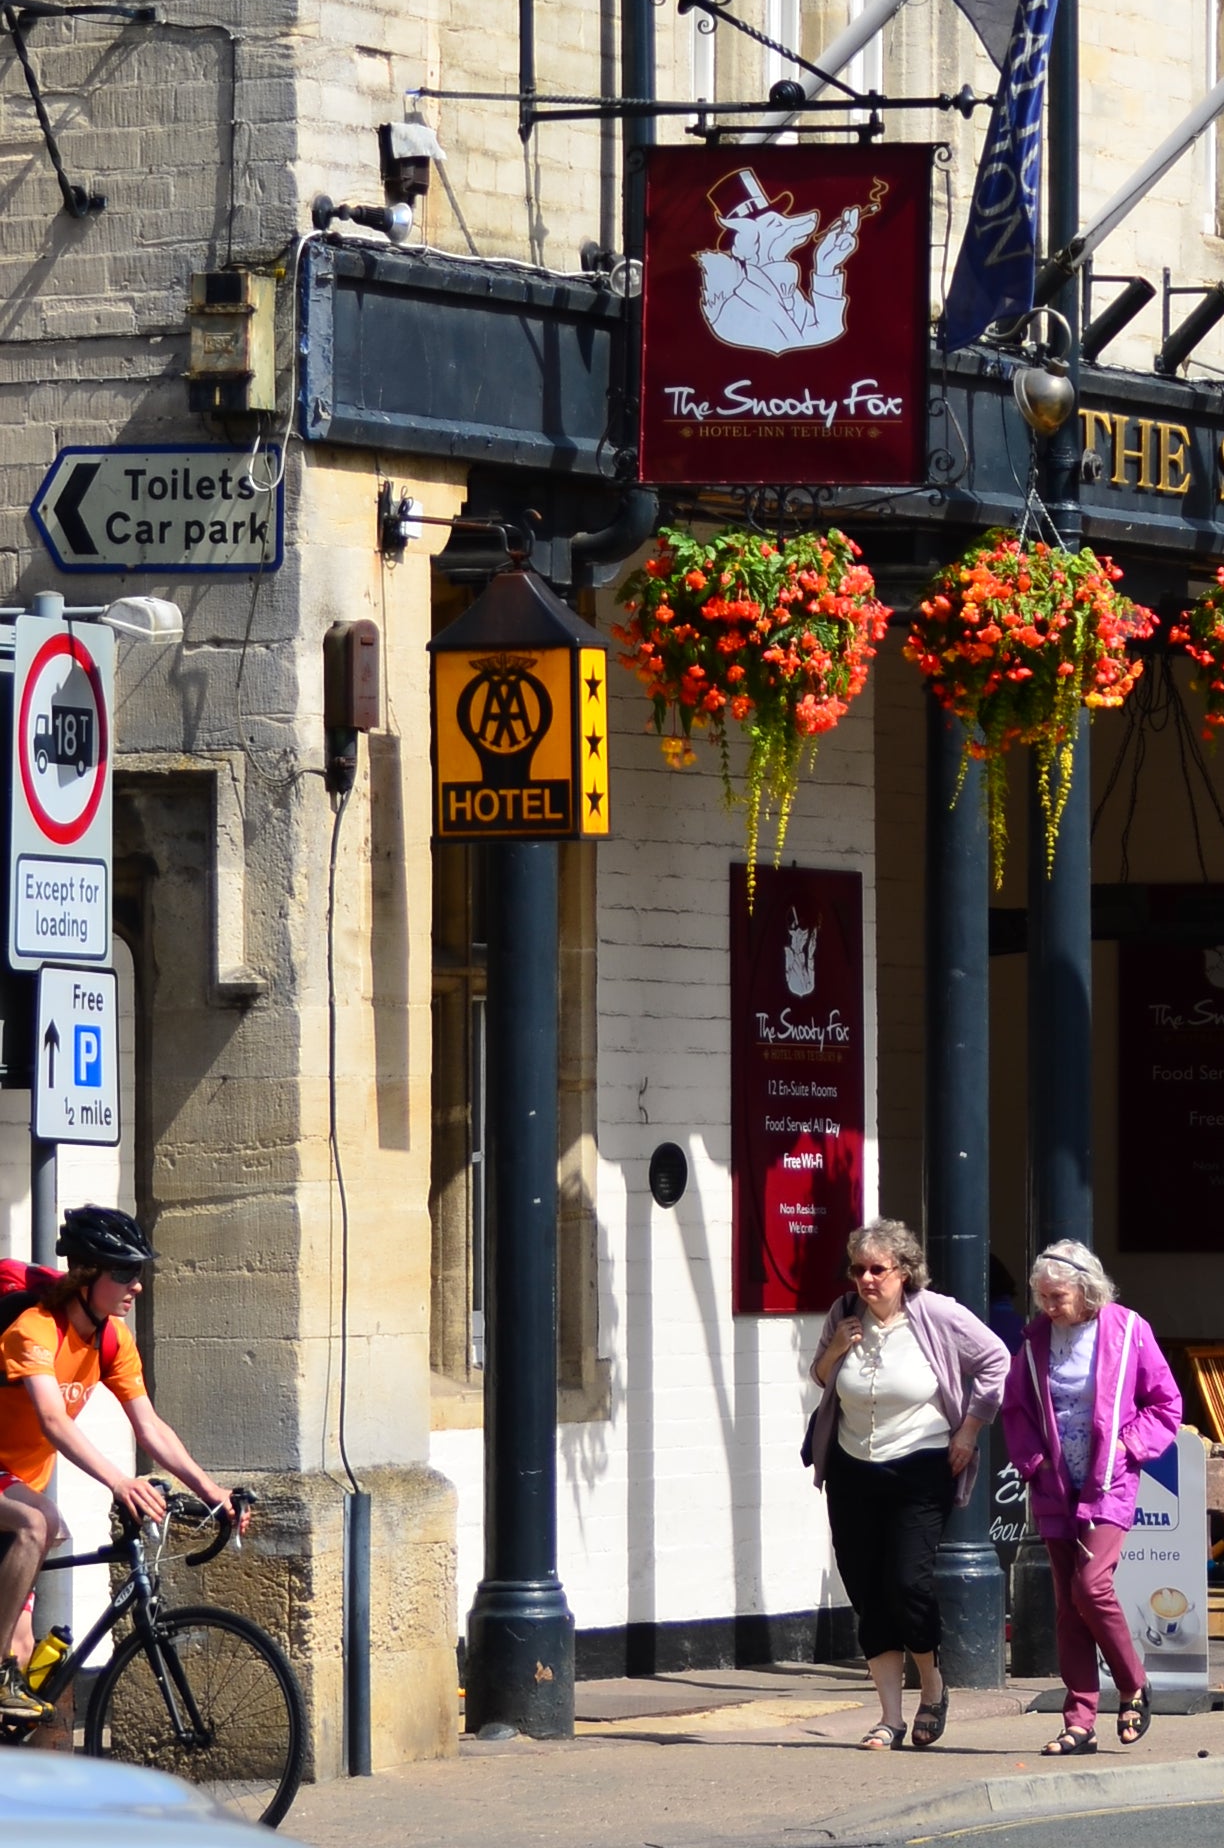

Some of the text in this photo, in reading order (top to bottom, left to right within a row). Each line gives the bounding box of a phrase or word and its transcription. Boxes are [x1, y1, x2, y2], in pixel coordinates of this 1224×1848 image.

[663, 378, 904, 429] The Snooty Fox
[698, 425, 866, 439] HOTEL-INN TETBURY
[1078, 407, 1192, 495] THE
[124, 467, 256, 501] Toilets
[105, 511, 270, 551] Car park
[478, 677, 536, 748] AA
[450, 788, 563, 822] HOTEL
[25, 873, 100, 907] Except for
[35, 909, 89, 943] loading
[73, 983, 104, 1012] Free
[755, 1006, 850, 1052] The Snooty Fox
[1148, 1003, 1185, 1031] The
[79, 1031, 99, 1082] P
[1152, 1064, 1194, 1082] Food
[768, 1079, 838, 1098] 12 En-Suite Rooms
[80, 1098, 113, 1126] mile
[1188, 1110, 1224, 1128] Free
[765, 1115, 841, 1138] Food Served All Day
[783, 1152, 823, 1170] Free Wi-Fi
[1192, 1159, 1220, 1172] Non
[779, 1202, 827, 1217] Non Residents
[788, 1220, 819, 1236] Welcome
[1132, 1506, 1172, 1527] AZZA
[1119, 1548, 1181, 1562] ved here
